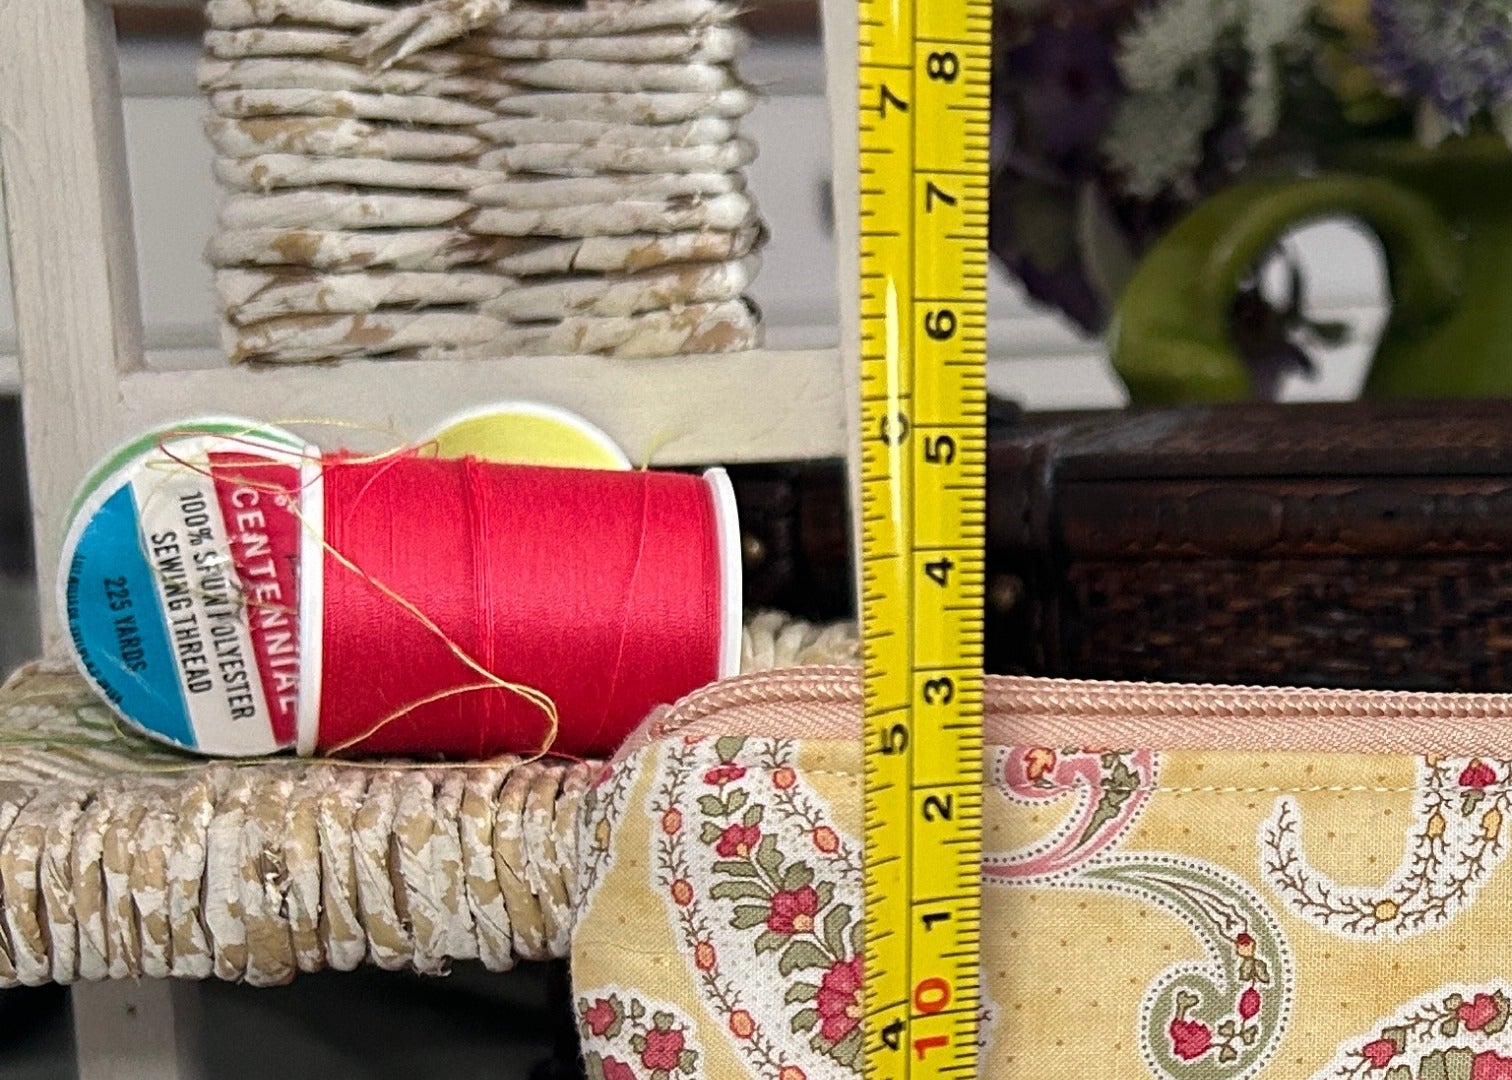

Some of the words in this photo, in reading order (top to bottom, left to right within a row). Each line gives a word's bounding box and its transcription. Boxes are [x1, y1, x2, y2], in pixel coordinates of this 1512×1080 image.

[926, 52, 959, 84] 8
[880, 84, 909, 118] 7
[926, 181, 957, 213] 7
[925, 309, 957, 341] 6
[923, 435, 956, 465] 5
[180, 490, 215, 546] 100%
[152, 531, 193, 611] SEWING
[925, 557, 955, 588] 4
[104, 576, 132, 611] 225
[231, 486, 298, 716] CENTENNIAL
[113, 614, 148, 673] YARDS
[172, 614, 212, 694] THREAD
[923, 677, 954, 705] 3
[880, 723, 909, 755] 5
[923, 793, 953, 821] 2
[922, 911, 951, 931] 1
[882, 1018, 906, 1050] 4
[914, 977, 950, 1060] 10
